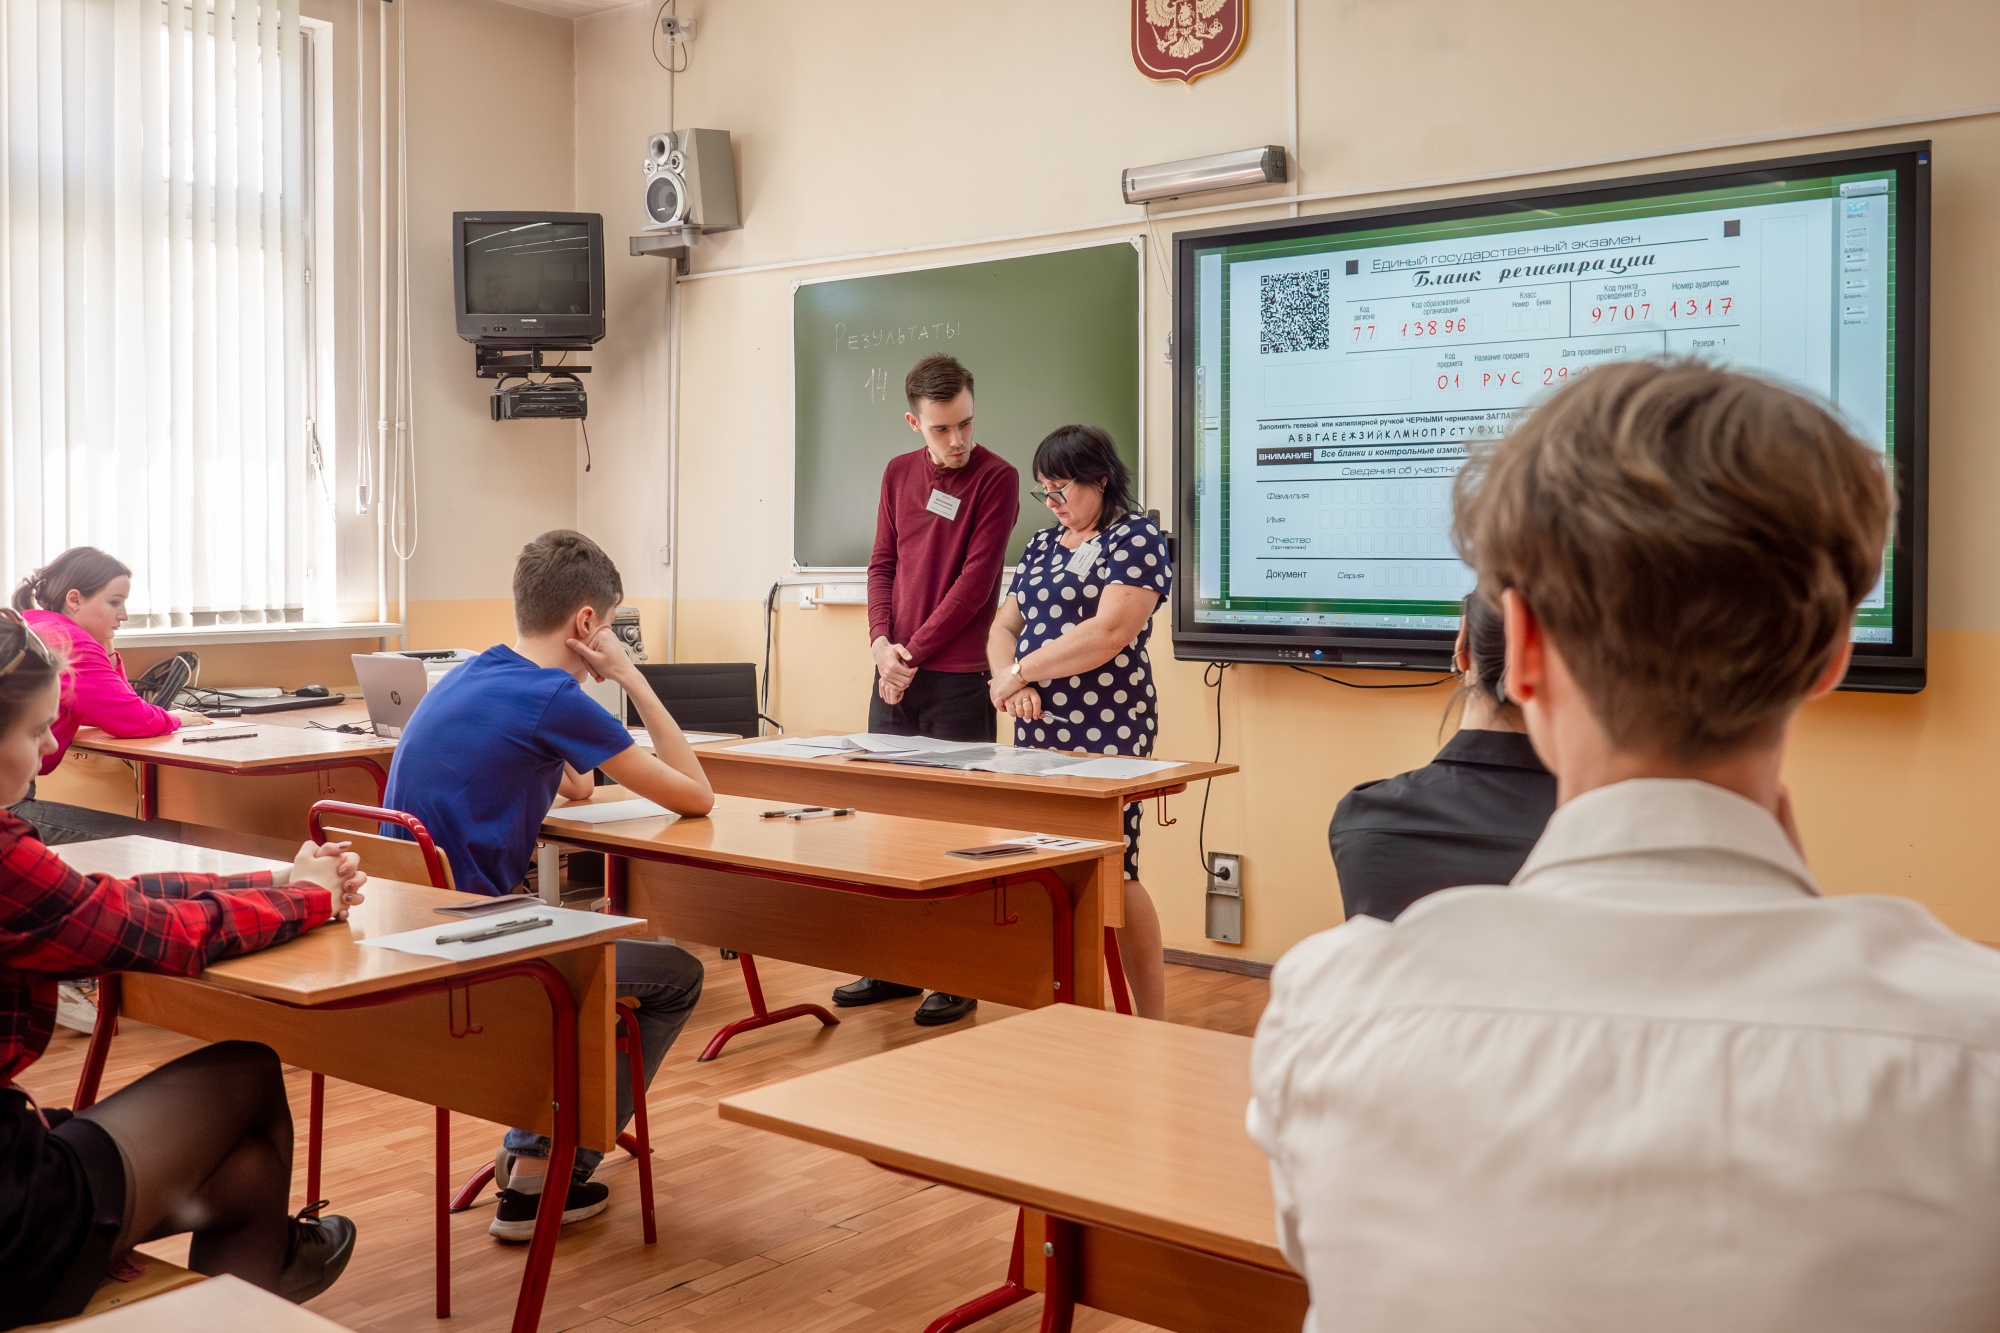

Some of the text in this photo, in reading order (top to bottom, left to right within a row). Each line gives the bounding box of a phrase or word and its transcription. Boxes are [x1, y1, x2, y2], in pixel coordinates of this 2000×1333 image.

[1372, 235, 1641, 271] Единый государственный экзамен
[1412, 254, 1657, 287] Бланк регистрации
[1604, 283, 1639, 292] Код пункта
[1672, 280, 1729, 290] Номер аудитории
[1519, 291, 1537, 299] Класс
[1596, 289, 1647, 300] проведения ЕГЭ
[1411, 297, 1470, 309] Код образовательной
[1512, 298, 1551, 309] Номер Буква
[1359, 306, 1370, 314] Код
[1423, 306, 1459, 315] организации
[1354, 314, 1375, 322] региона
[1444, 352, 1455, 360] Код
[1503, 352, 1530, 360] предмета
[1561, 345, 1627, 358] Дата проведения ЕГЭ
[1437, 360, 1463, 368] предмета
[864, 367, 887, 403] 14
[1293, 421, 1318, 429] гелевой
[1334, 418, 1378, 427] капиллярной
[1380, 415, 1404, 426] ручкой
[1444, 415, 1484, 423] чернилами
[1258, 452, 1312, 460] ВНИМАНИЕ!
[1321, 450, 1335, 458] Все
[1337, 448, 1366, 457] бланки
[1375, 447, 1434, 457] контрольные
[1342, 467, 1396, 476] Сведения
[1398, 466, 1412, 474] об
[1266, 536, 1311, 544] Отчество
[1266, 569, 1365, 580] Документ Серия
